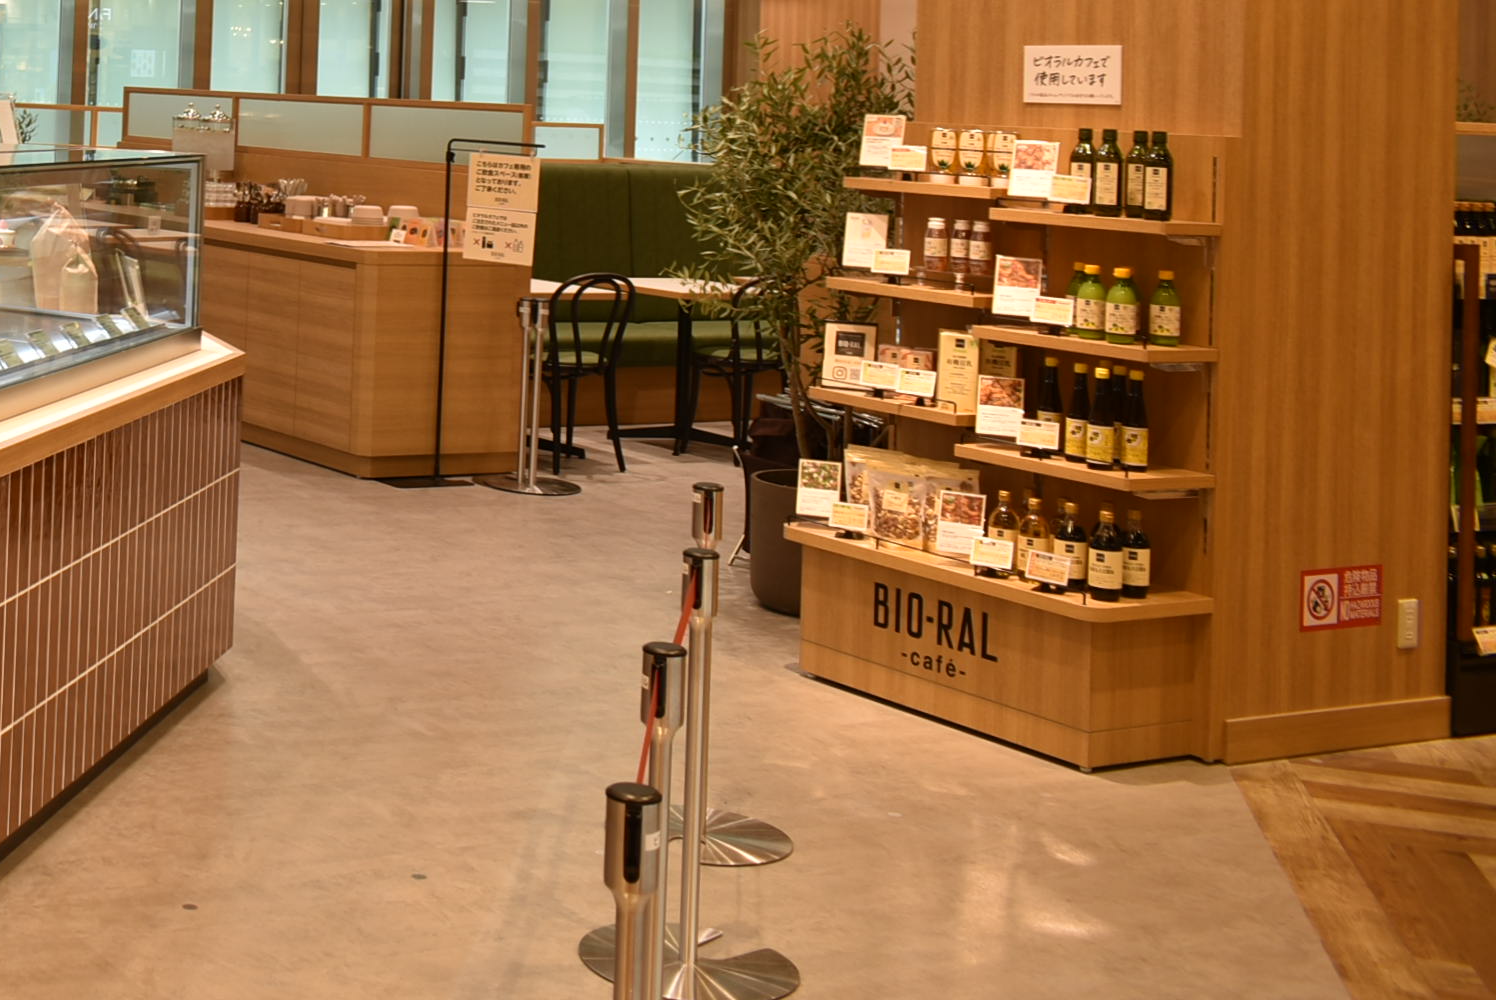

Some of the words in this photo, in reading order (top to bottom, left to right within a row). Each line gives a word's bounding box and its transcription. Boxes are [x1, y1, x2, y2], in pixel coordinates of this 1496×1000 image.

[1035, 71, 1107, 87] 使用しています
[873, 582, 999, 663] BIO-RAL
